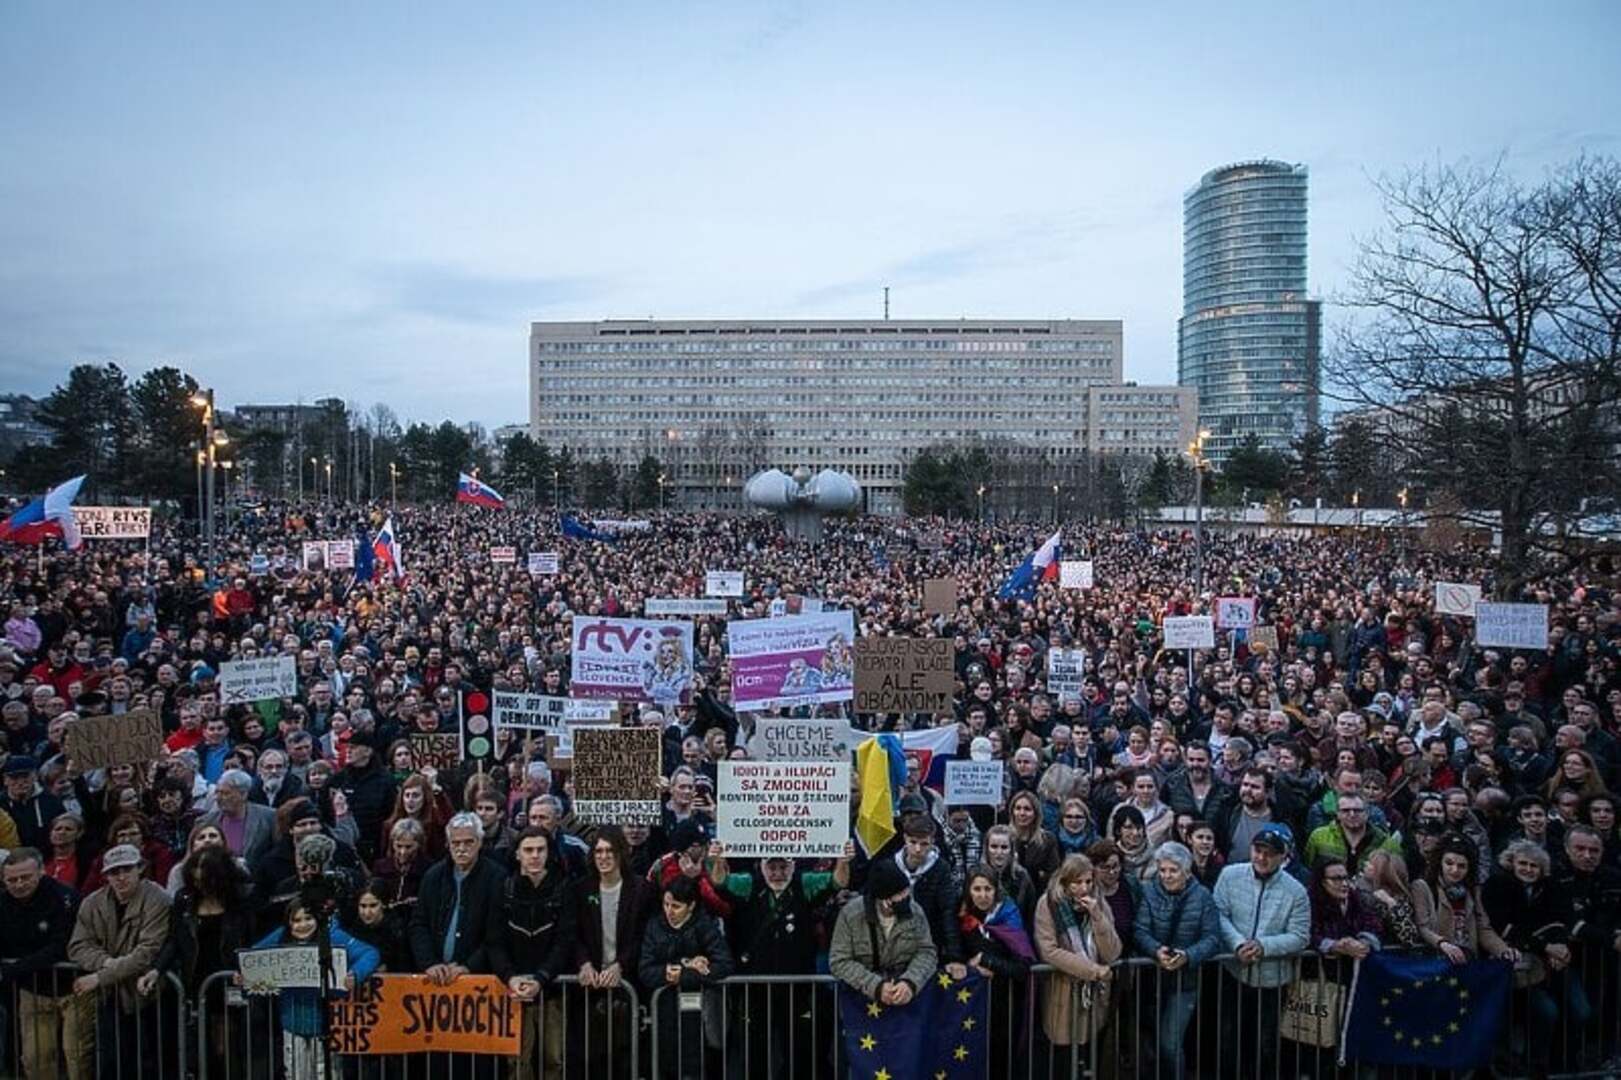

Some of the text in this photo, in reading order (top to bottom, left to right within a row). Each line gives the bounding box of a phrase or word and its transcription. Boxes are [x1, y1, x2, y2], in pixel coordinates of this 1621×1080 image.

[857, 639, 947, 655] SLOVENSKO
[880, 672, 926, 690] ALE
[500, 710, 561, 728] DEMOCRACY
[765, 726, 834, 740] CHCEME
[741, 780, 828, 791] SA ZMOCNILI
[721, 793, 775, 803] KONTROLY
[778, 794, 799, 803] NAD
[759, 805, 811, 816] SOM ZA
[760, 830, 808, 841] ODPOR
[725, 843, 757, 853] PROTI
[760, 843, 801, 854] FICOVEJ
[328, 1026, 371, 1052] SNS
